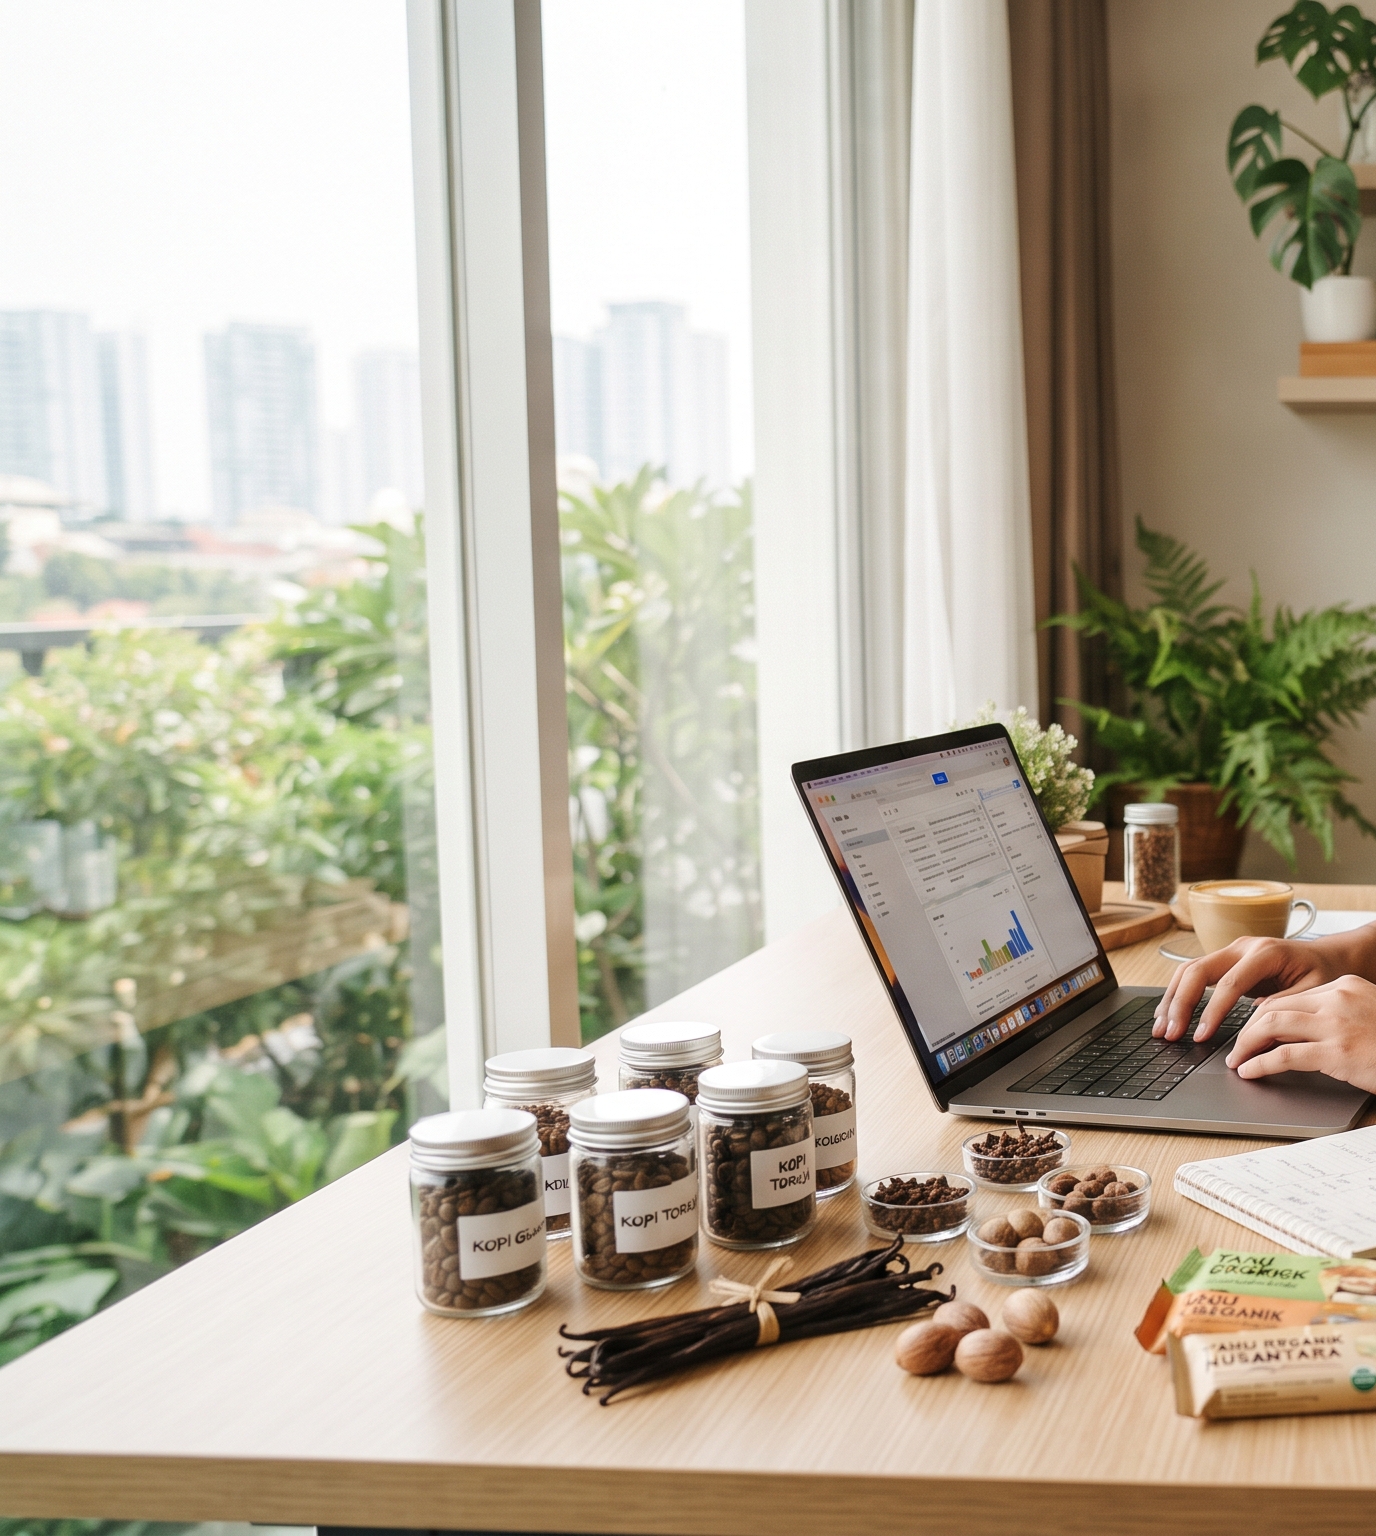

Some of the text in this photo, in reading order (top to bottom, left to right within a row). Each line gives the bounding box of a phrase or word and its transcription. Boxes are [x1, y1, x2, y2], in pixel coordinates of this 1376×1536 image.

[778, 1153, 806, 1173] KOPI
[621, 1211, 658, 1228] KOPI
[473, 1234, 511, 1252] KOPI
